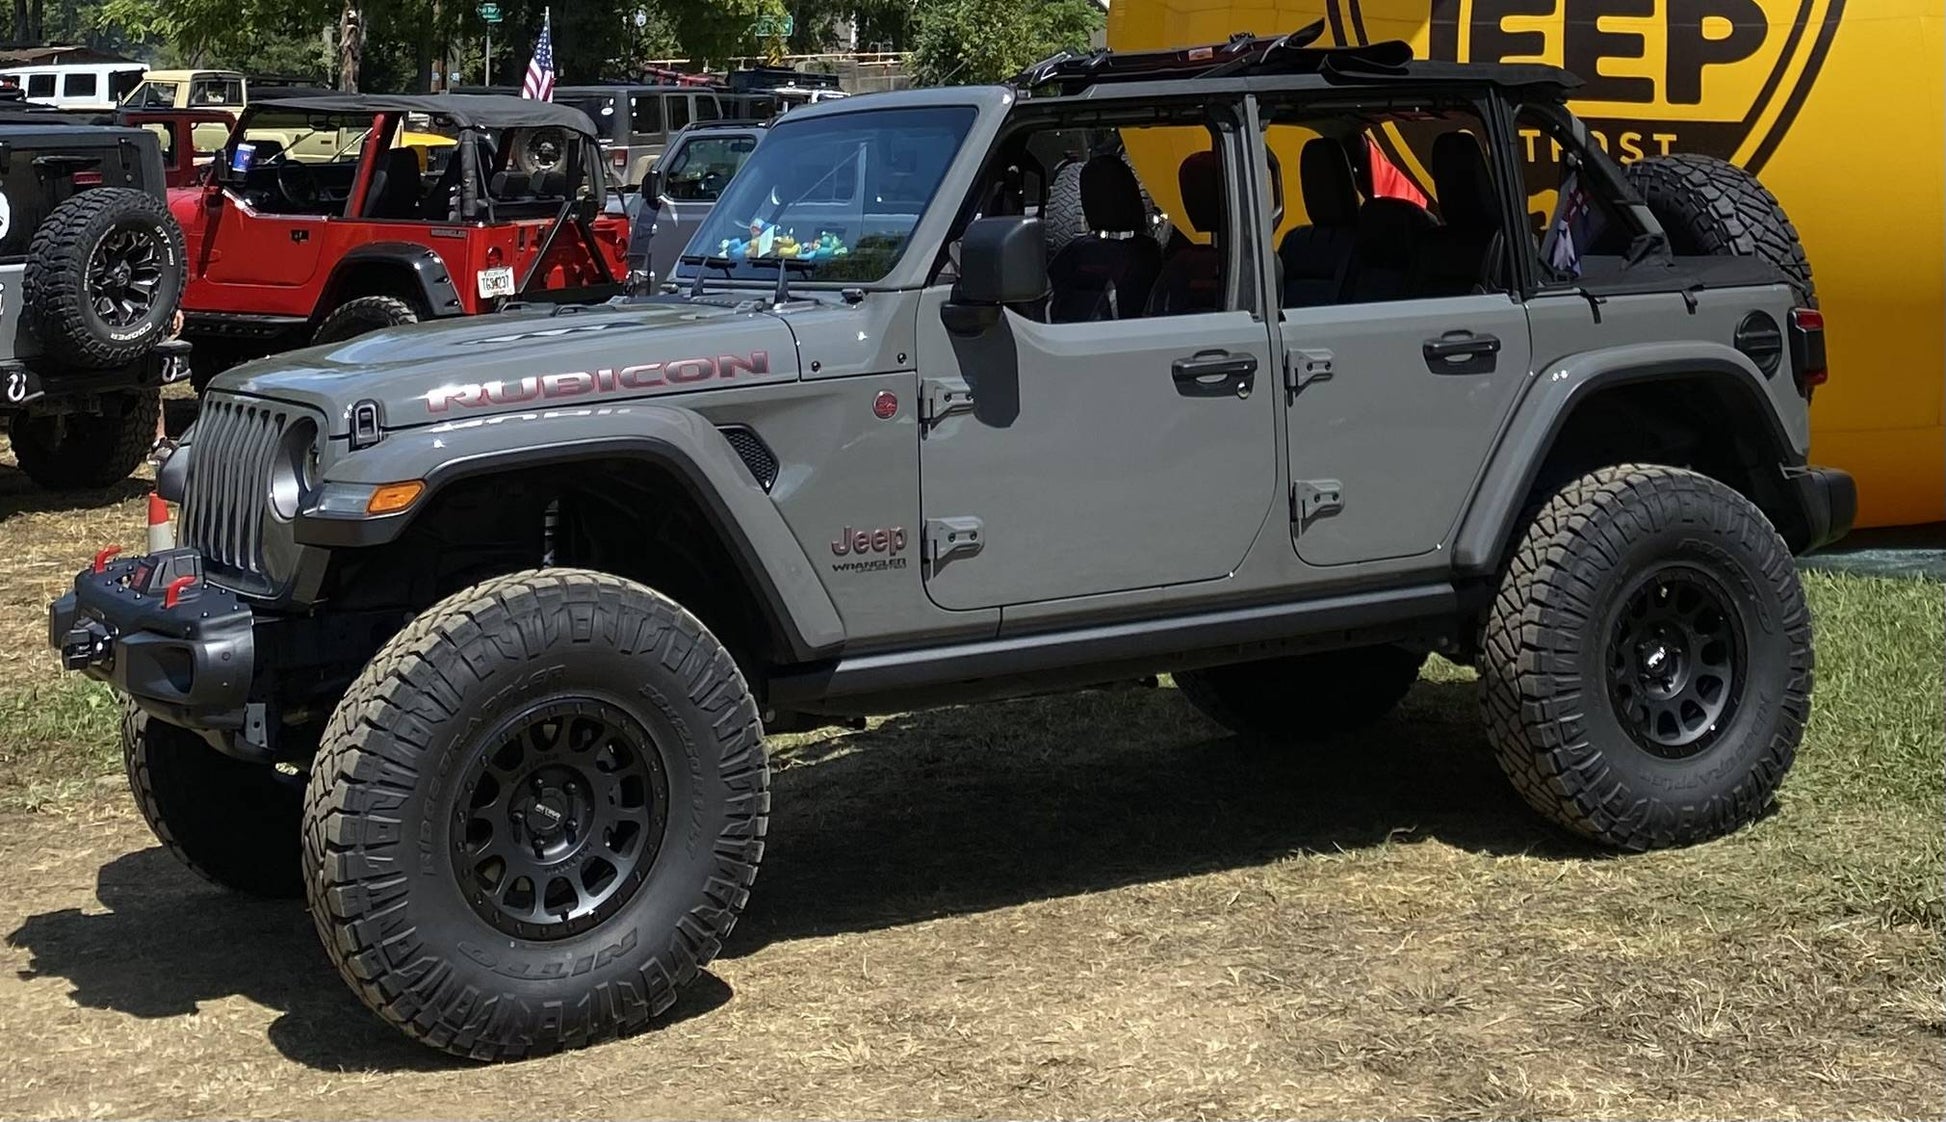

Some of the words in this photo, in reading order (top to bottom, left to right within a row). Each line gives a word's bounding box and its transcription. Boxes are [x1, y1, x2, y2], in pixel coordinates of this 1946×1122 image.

[110, 321, 152, 341] COOPER
[425, 350, 769, 413] RUBICON
[831, 525, 908, 557] Jeep
[832, 558, 907, 572] WRANGLER
